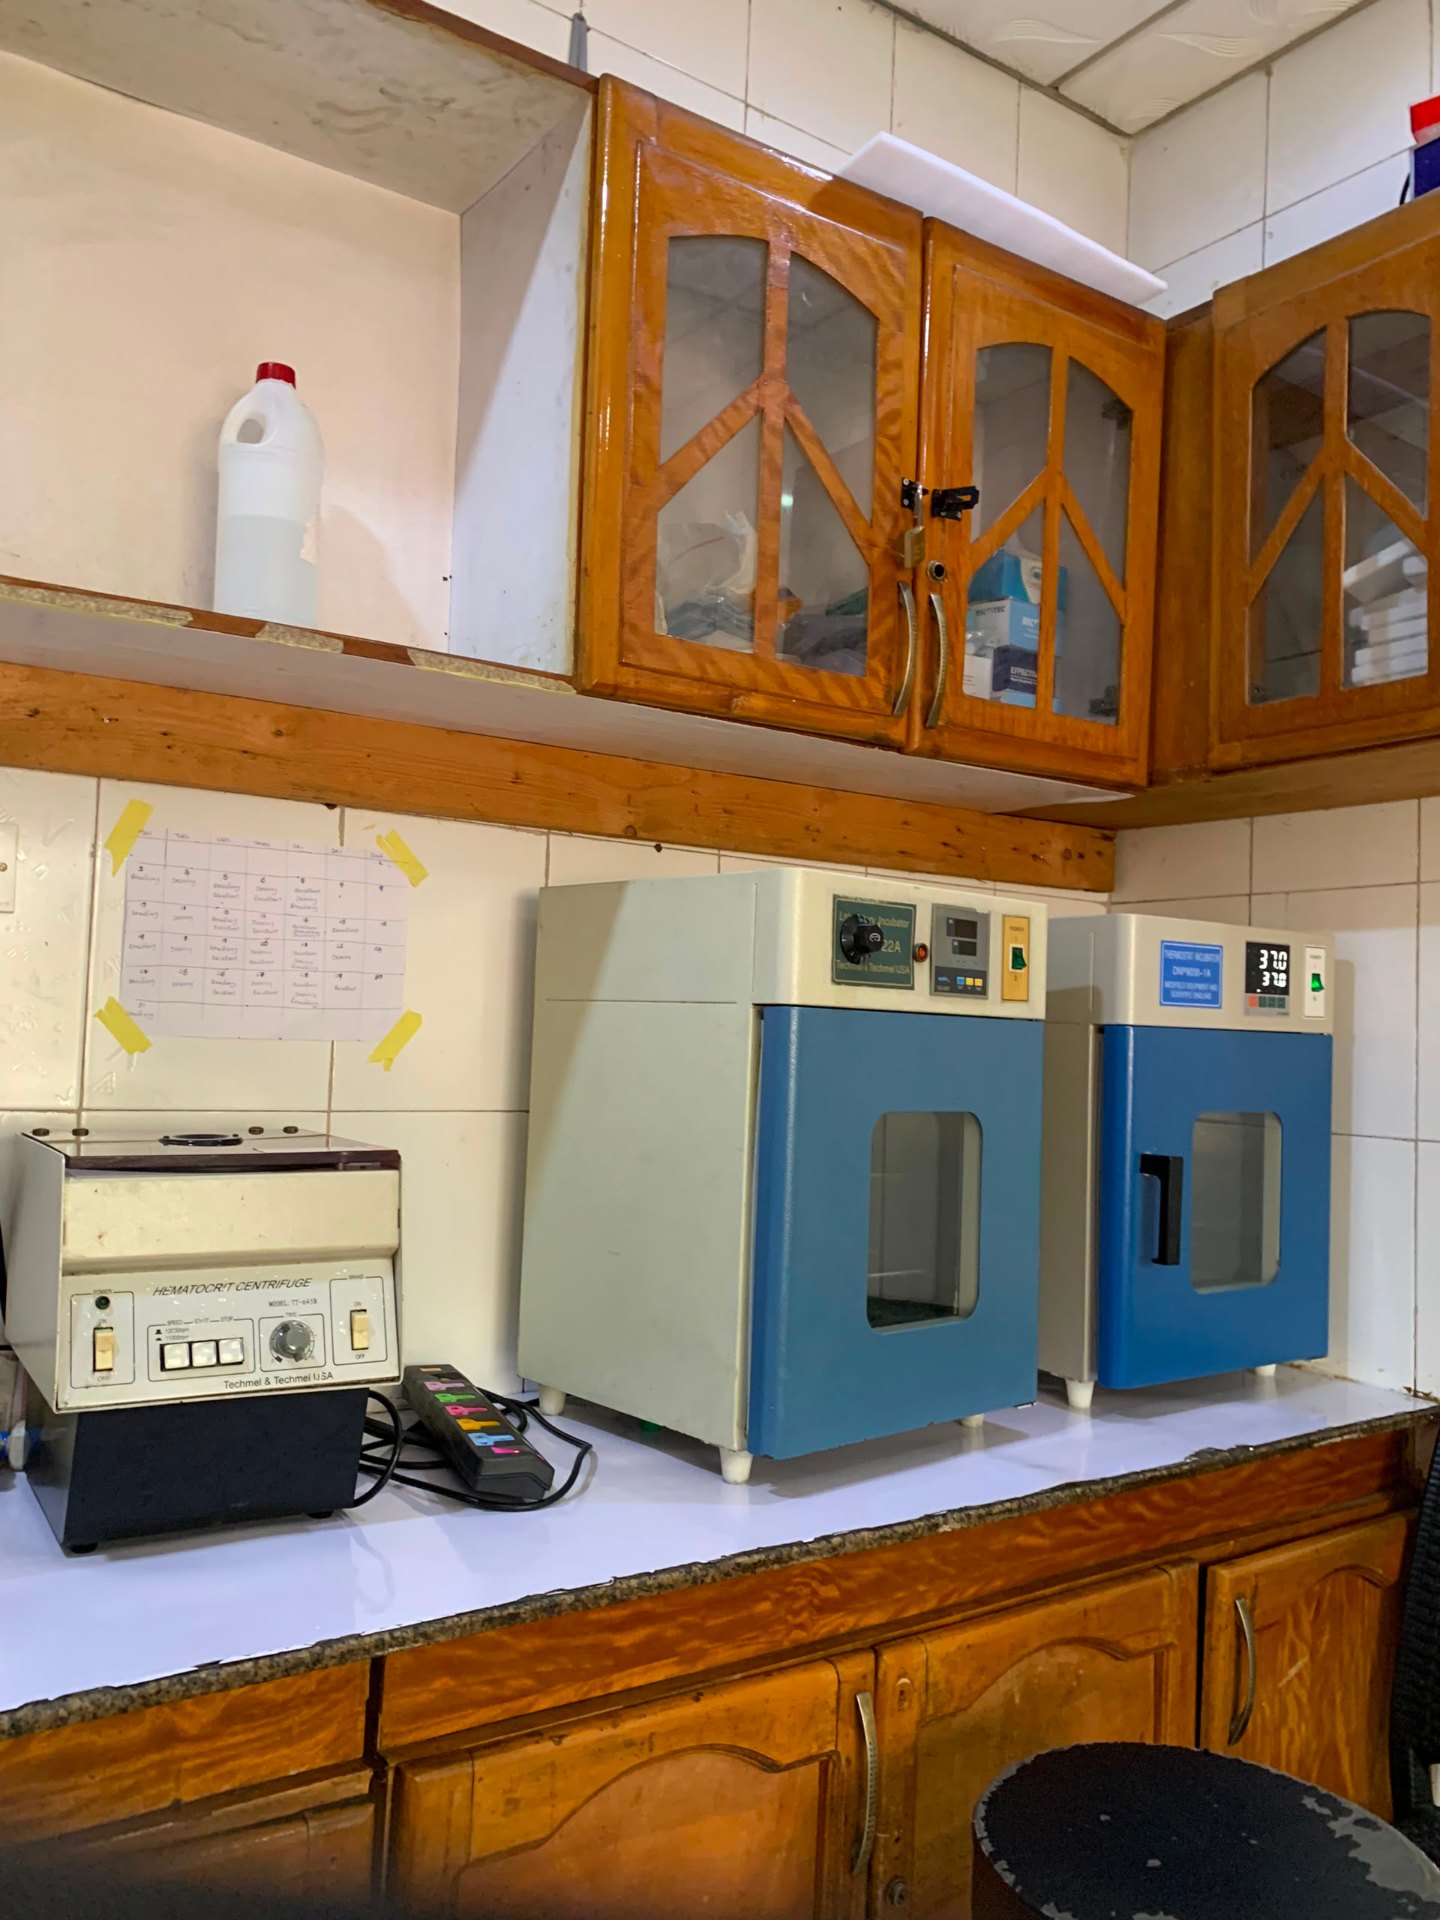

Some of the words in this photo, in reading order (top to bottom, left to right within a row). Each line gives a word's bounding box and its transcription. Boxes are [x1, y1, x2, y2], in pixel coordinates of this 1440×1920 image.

[152, 1282, 236, 1297] HEMATOCRIT
[234, 1277, 313, 1292] CENTRIFUGE
[224, 1378, 262, 1391] Techmel
[264, 1376, 273, 1387] &
[274, 1373, 312, 1385] Techmel
[313, 1371, 335, 1382] USA
